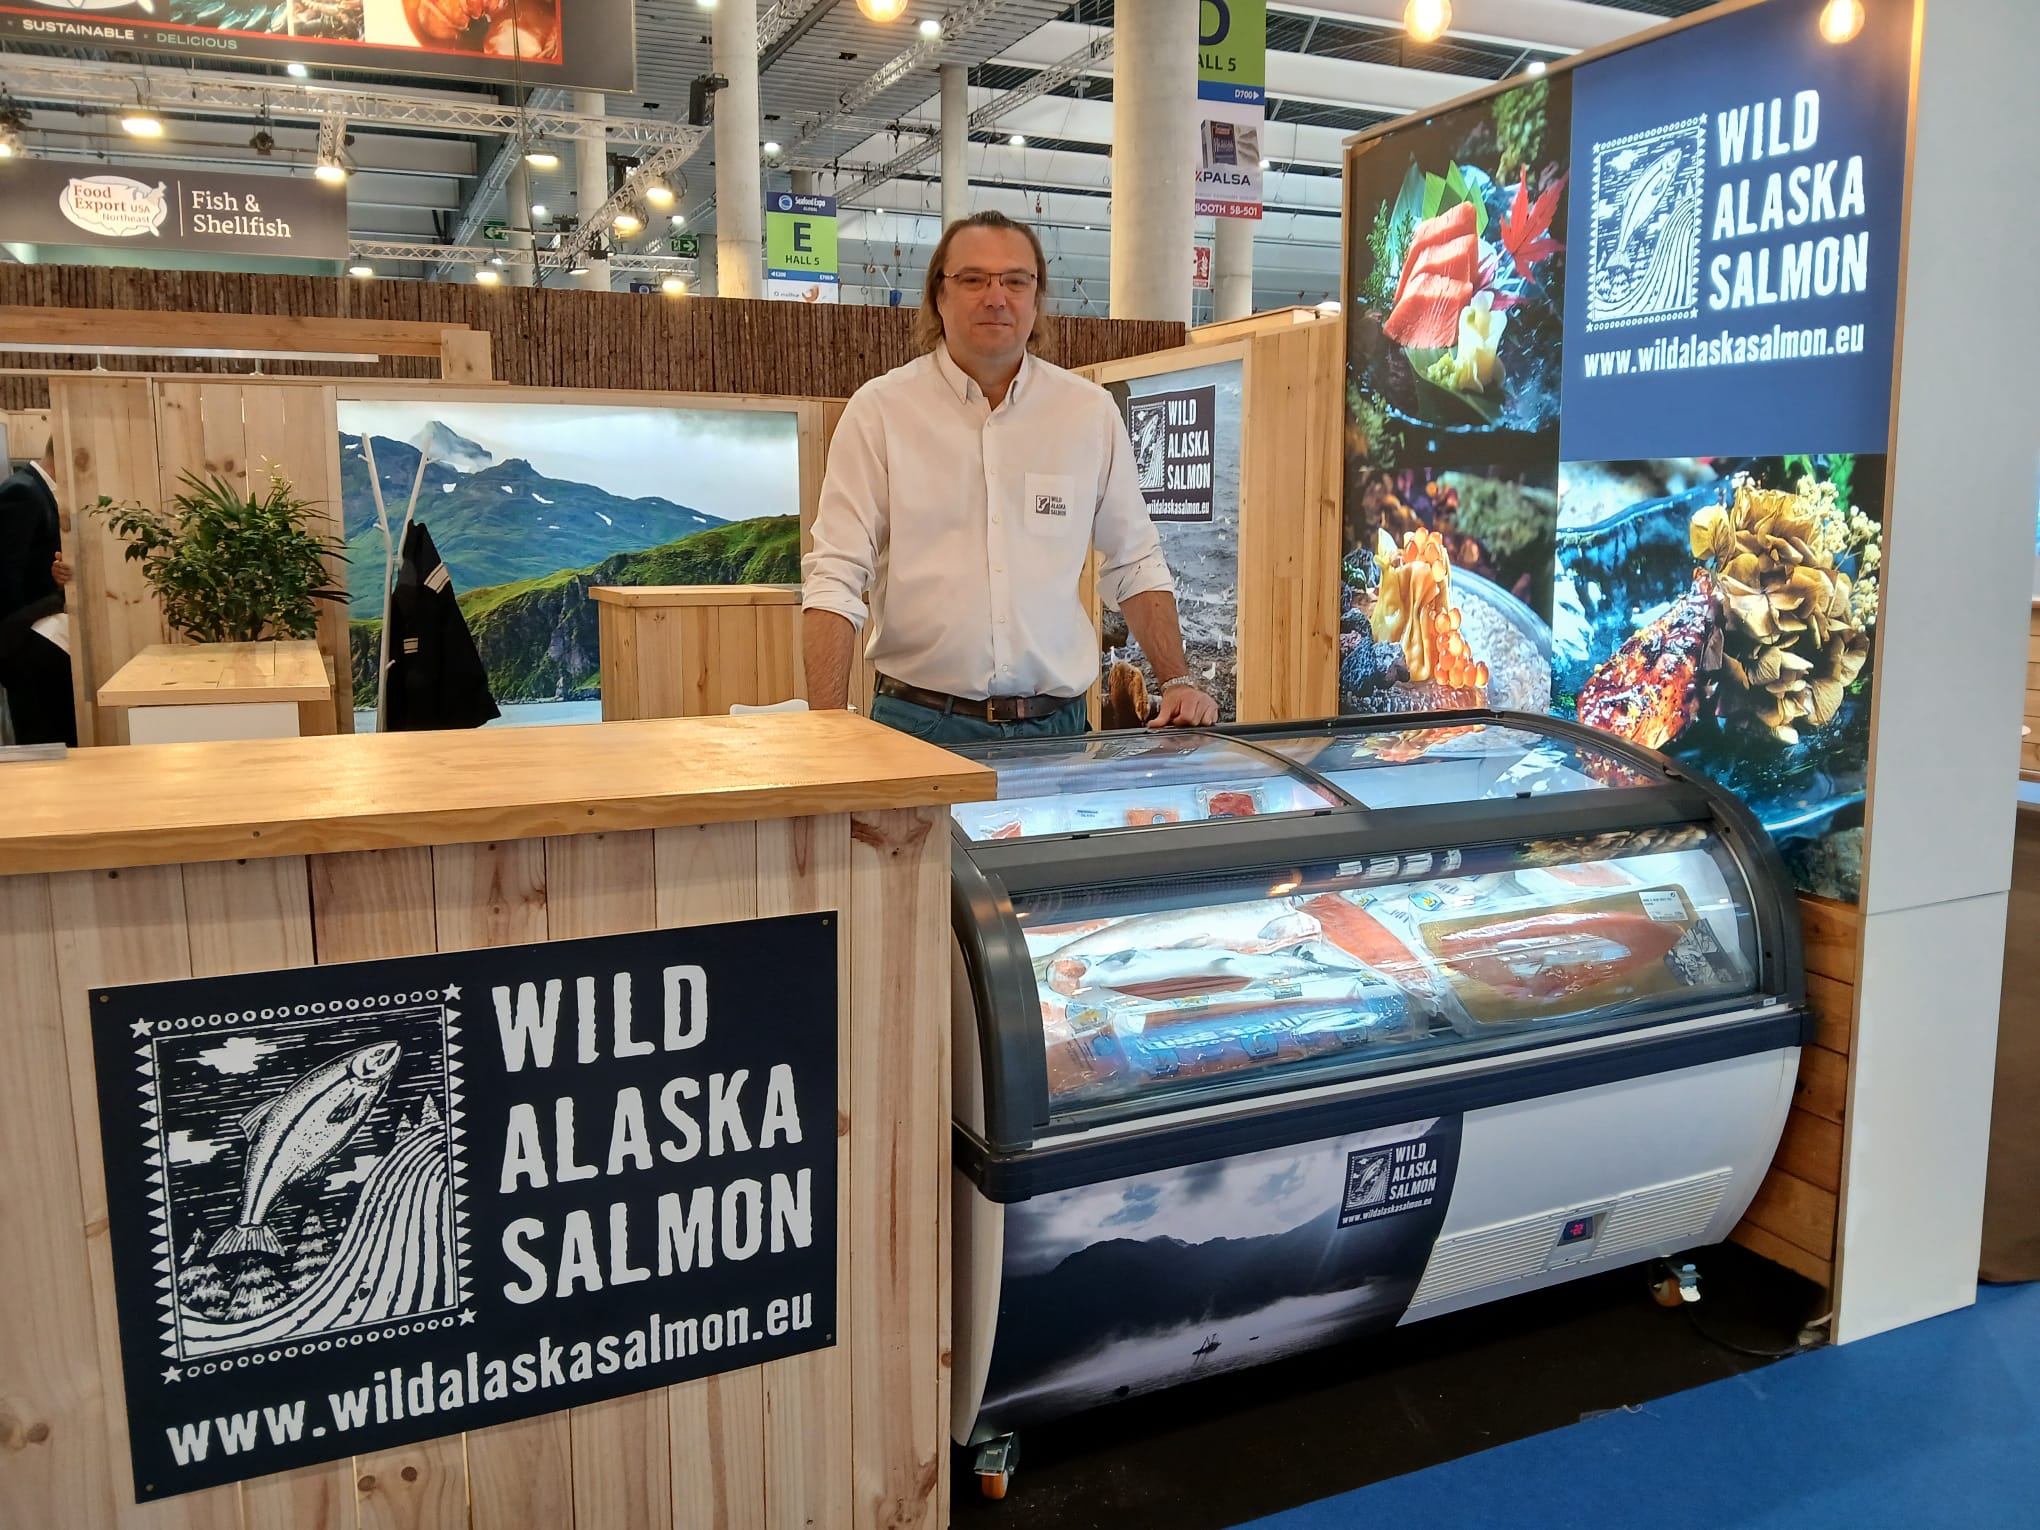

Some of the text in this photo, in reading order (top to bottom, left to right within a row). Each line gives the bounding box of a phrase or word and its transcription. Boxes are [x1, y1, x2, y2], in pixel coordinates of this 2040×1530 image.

[22, 19, 238, 50] SUSTAINABLE DELICIOUS
[1198, 53, 1236, 72] ALL 5
[1235, 89, 1253, 100] D700
[1717, 89, 1820, 167] WILD
[1195, 169, 1251, 186] XPALSA
[74, 184, 111, 199] Food
[191, 190, 261, 213] Fish &
[1711, 155, 1866, 241] ALASKA
[75, 198, 151, 214] Export USA
[102, 212, 151, 225] Northeast
[1195, 203, 1258, 216] BOOTH 5B-501
[193, 214, 292, 239] Shellfish
[793, 222, 812, 252] E
[785, 255, 820, 266] HALL 5
[1708, 231, 1870, 311] SALMON
[1584, 323, 1865, 379] www.wildalaskasalmon.eu
[1168, 399, 1197, 426] WILD
[1167, 430, 1210, 458] ALASKA
[1167, 463, 1211, 490] SALMON
[491, 964, 708, 1073] WILD
[499, 1063, 804, 1194] ALASKA
[1395, 1142, 1427, 1163] WILD
[1391, 1159, 1437, 1183] ALASKA
[1389, 1177, 1437, 1201] SALMON
[1342, 1197, 1433, 1225] www.wildalaskasalmon.eu
[500, 1168, 813, 1305] SALMON
[166, 1292, 813, 1467] www.wildalaskasalmon.eu
